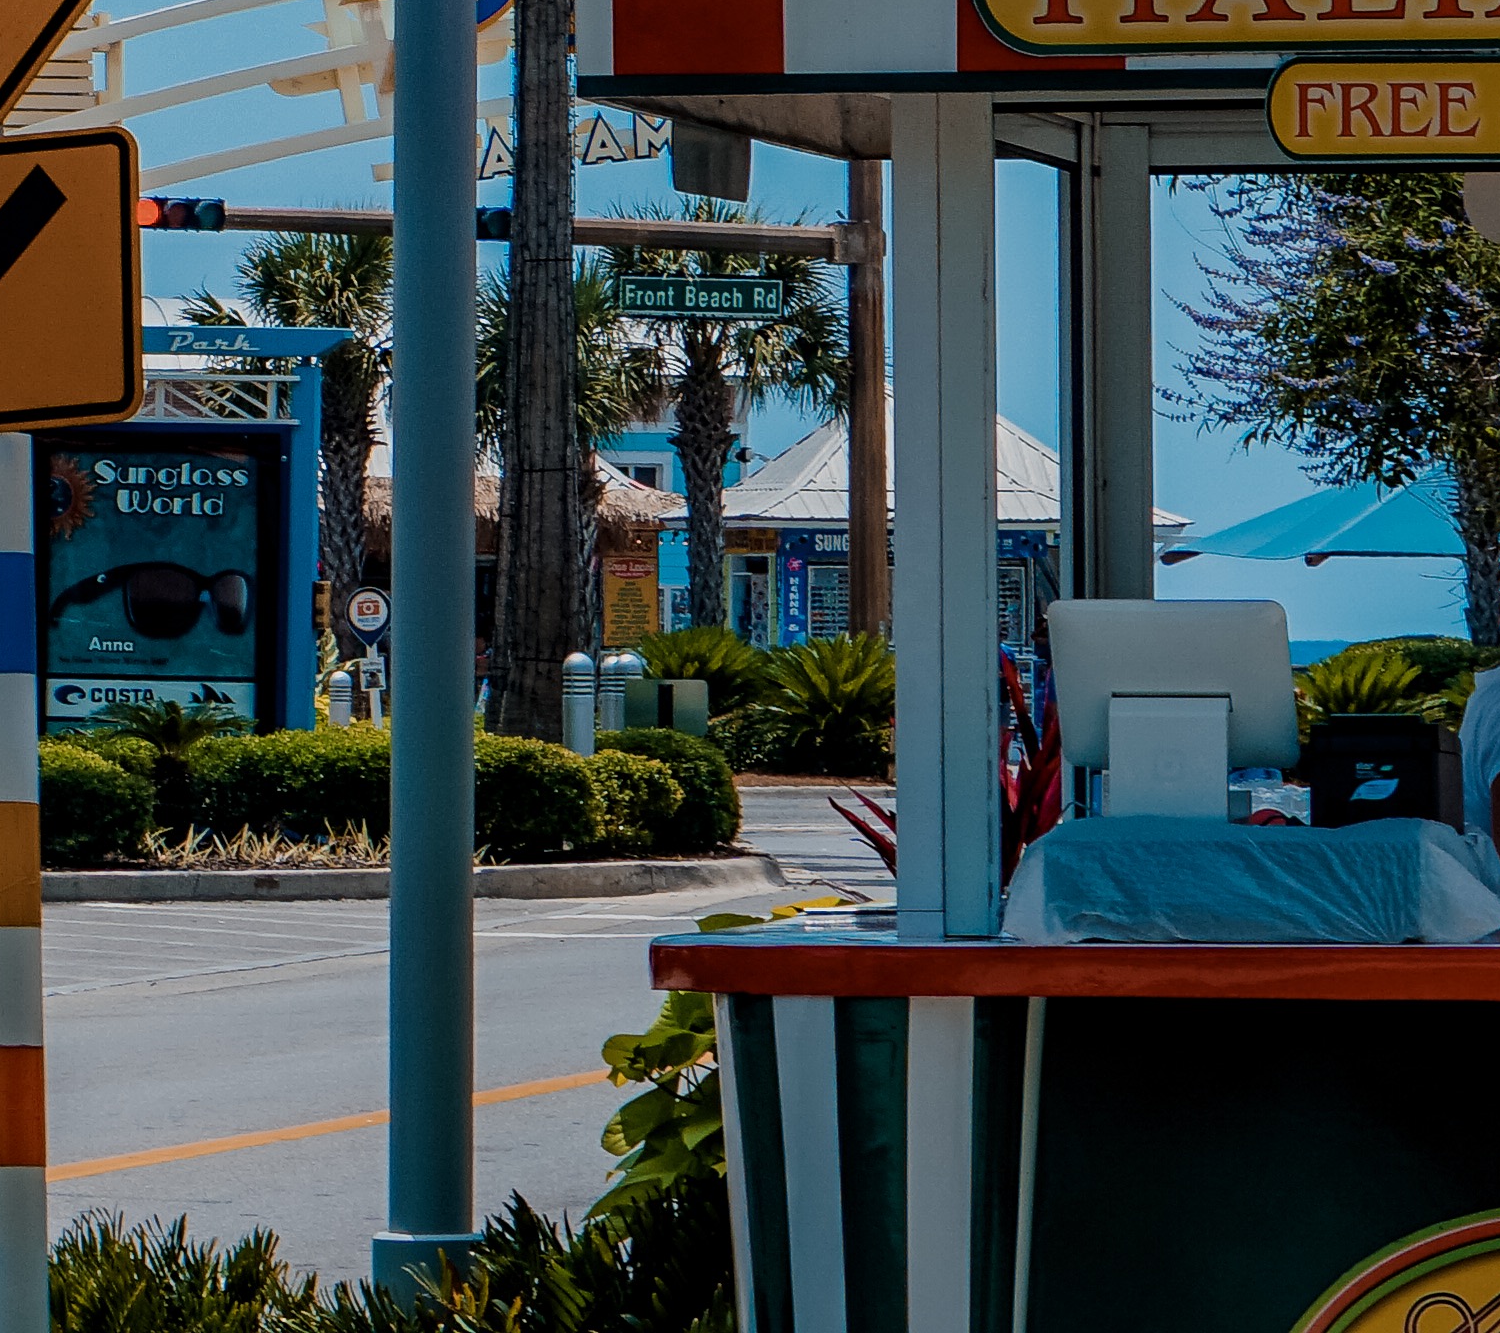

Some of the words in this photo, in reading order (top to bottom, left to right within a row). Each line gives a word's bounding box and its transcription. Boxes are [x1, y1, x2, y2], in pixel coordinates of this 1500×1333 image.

[1292, 79, 1482, 140] FREE
[625, 284, 674, 306] Front
[685, 285, 742, 308] Beach
[753, 287, 777, 309] Rd
[167, 331, 261, 351] Park
[94, 459, 249, 490] Sunglass
[116, 488, 224, 516] World
[815, 533, 849, 552] SUNG
[88, 636, 134, 652] Anna
[90, 687, 154, 704] COSTA
